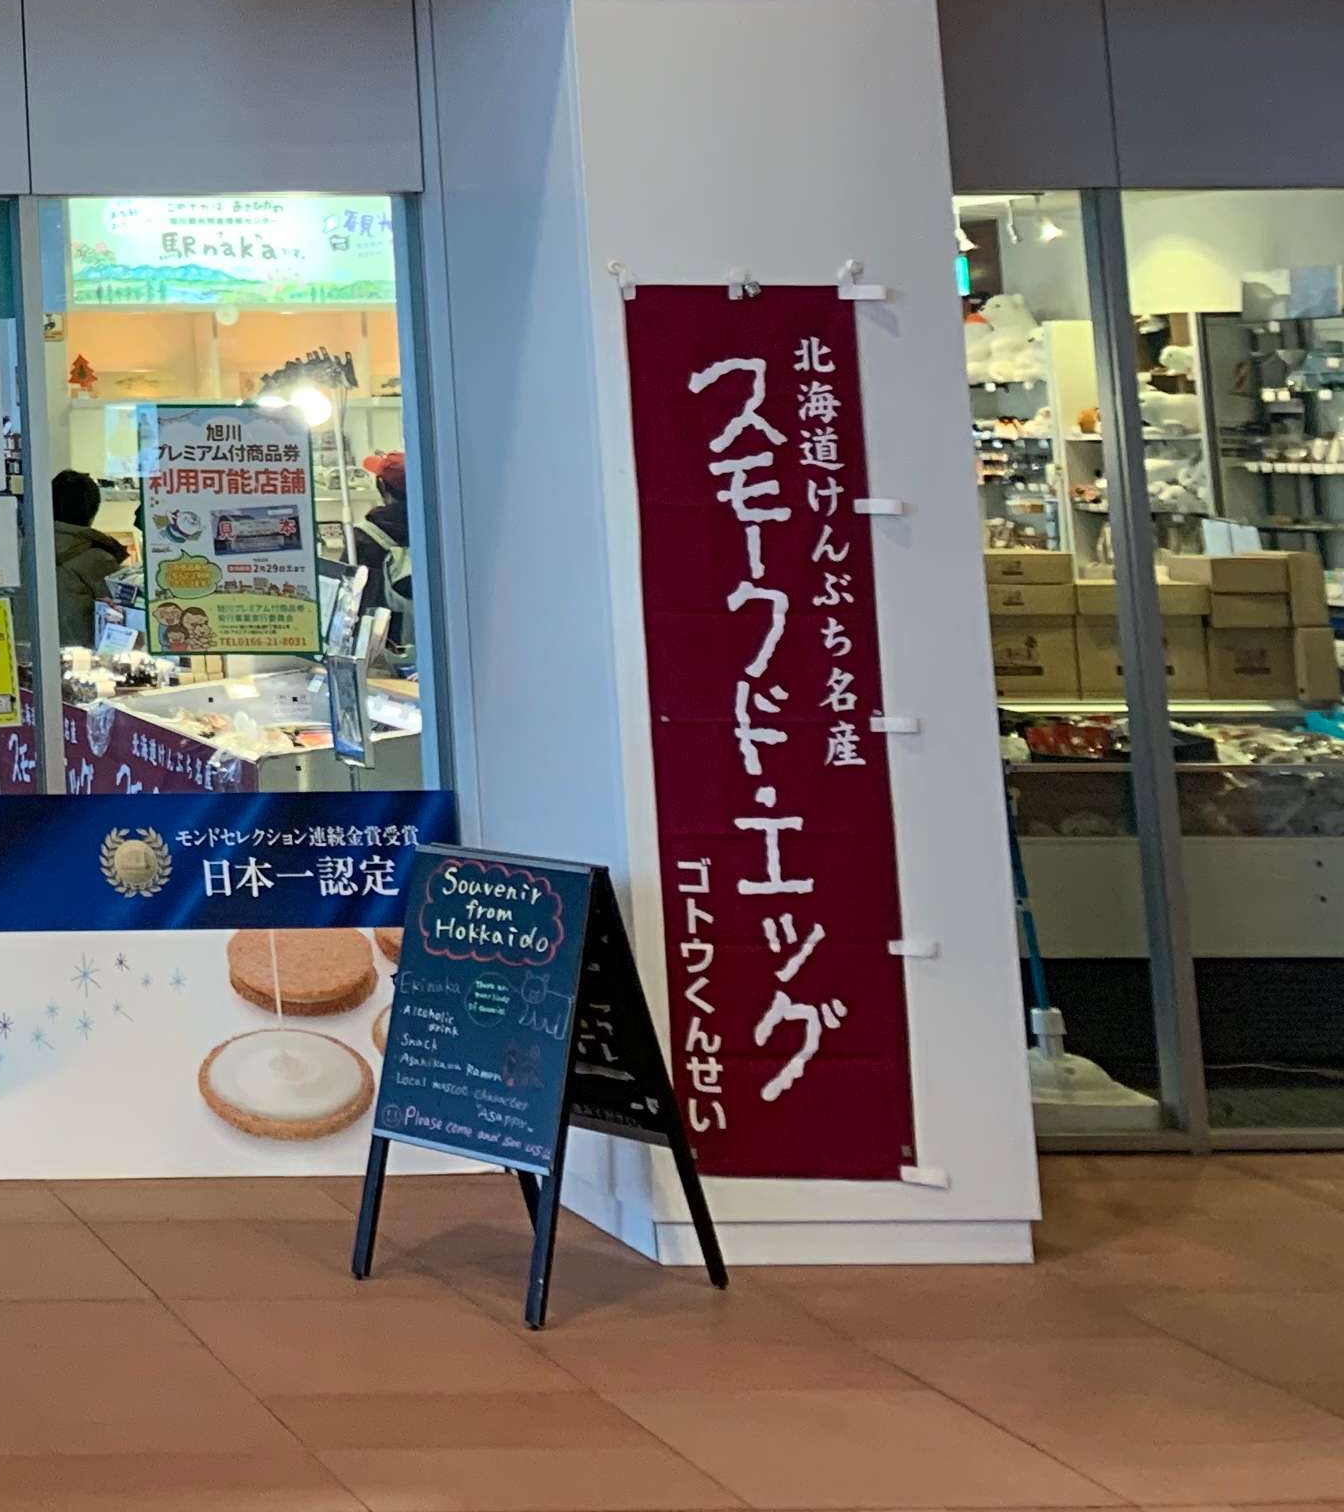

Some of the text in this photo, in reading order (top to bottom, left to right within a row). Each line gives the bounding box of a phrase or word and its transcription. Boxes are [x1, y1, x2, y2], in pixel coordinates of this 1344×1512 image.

[206, 423, 243, 442] 旭川
[158, 443, 301, 463] プレミアム付商品券
[148, 468, 307, 495] 利用可能店舗
[792, 336, 867, 767] 北海道けんぶち名産
[688, 357, 849, 1102] スモークド・エッグ
[174, 824, 420, 849] モンドセレクション連続金賞受賞
[202, 855, 400, 898] 日本一認定
[442, 867, 543, 905] Souvenir
[465, 900, 513, 922] from
[435, 919, 549, 953] Hokkaido
[676, 858, 727, 1133] ゴトウくんせい
[402, 1004, 455, 1025] Alcoholic
[400, 1033, 439, 1051] Snack
[395, 1072, 427, 1088] Local
[465, 1062, 504, 1083] Ramen
[404, 1105, 442, 1130] Please
[444, 1122, 473, 1139] come
